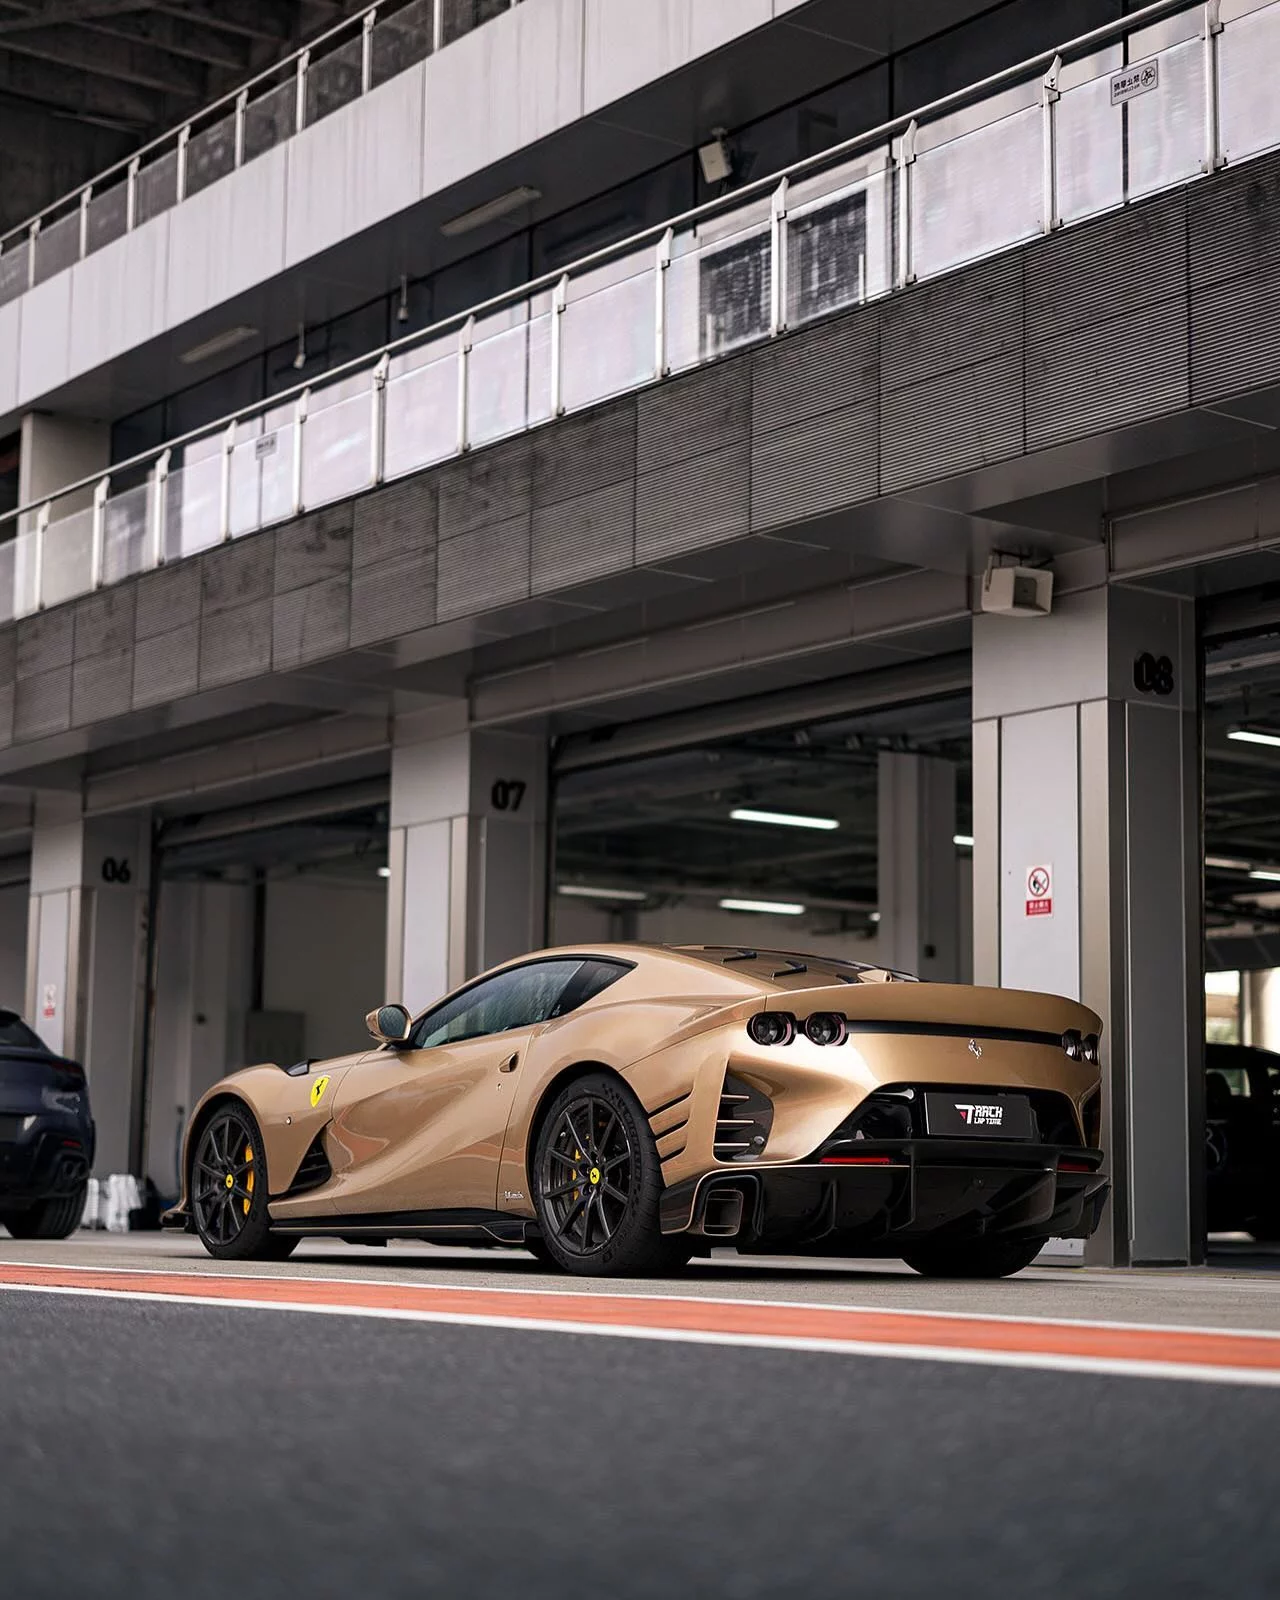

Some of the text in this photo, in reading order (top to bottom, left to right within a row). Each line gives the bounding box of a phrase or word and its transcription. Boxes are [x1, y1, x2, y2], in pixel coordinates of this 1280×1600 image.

[1133, 652, 1174, 695] 08
[491, 779, 527, 811] 07
[102, 857, 131, 883] 06
